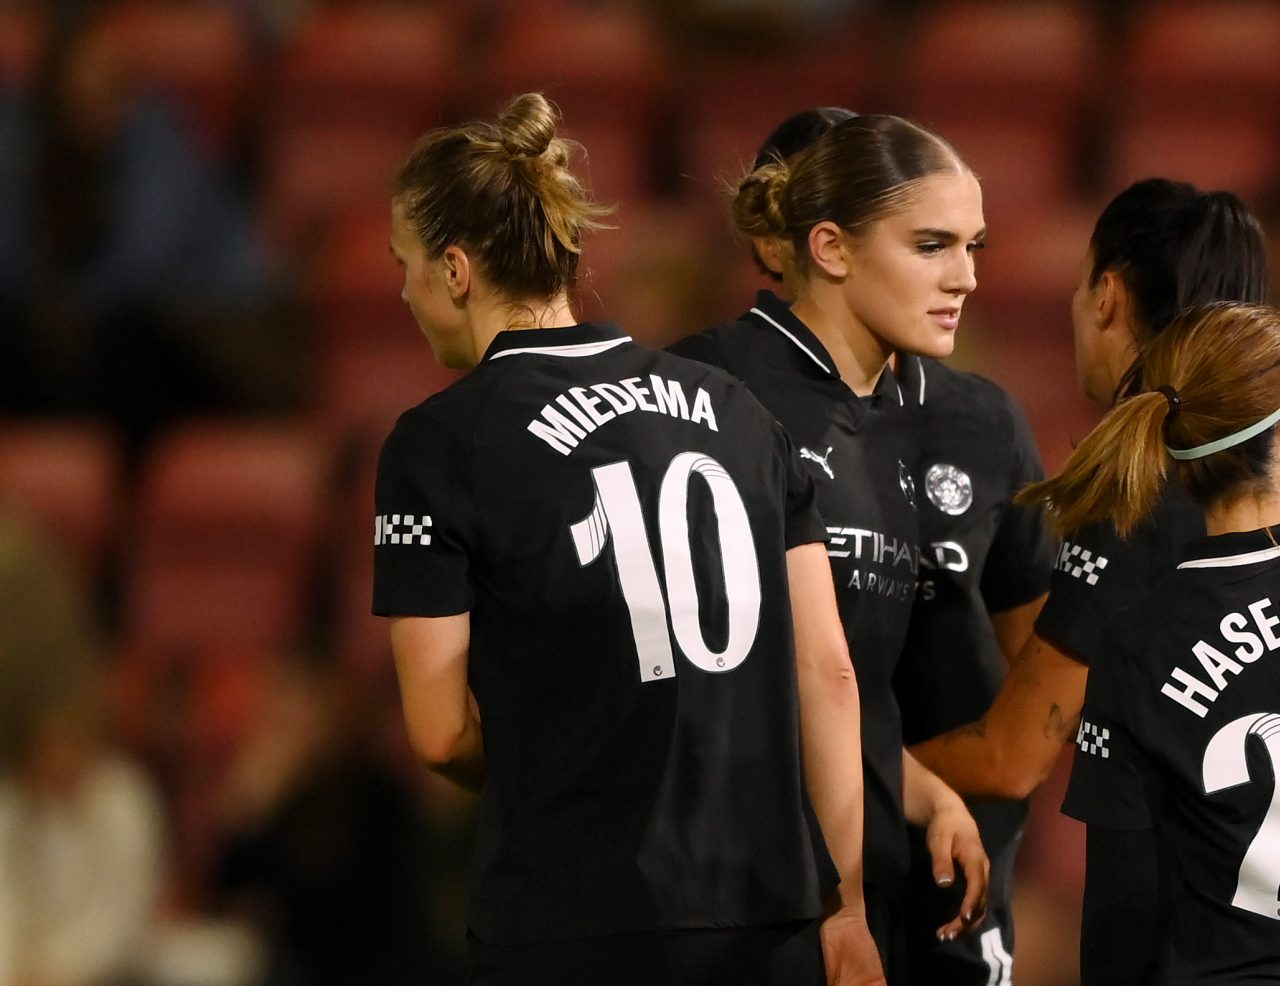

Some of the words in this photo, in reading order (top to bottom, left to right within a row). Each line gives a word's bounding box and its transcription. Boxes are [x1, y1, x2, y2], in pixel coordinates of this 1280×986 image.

[527, 374, 718, 455] MIEDEMA
[374, 514, 433, 546] KX
[570, 452, 762, 682] 10
[1055, 541, 1109, 586] KX
